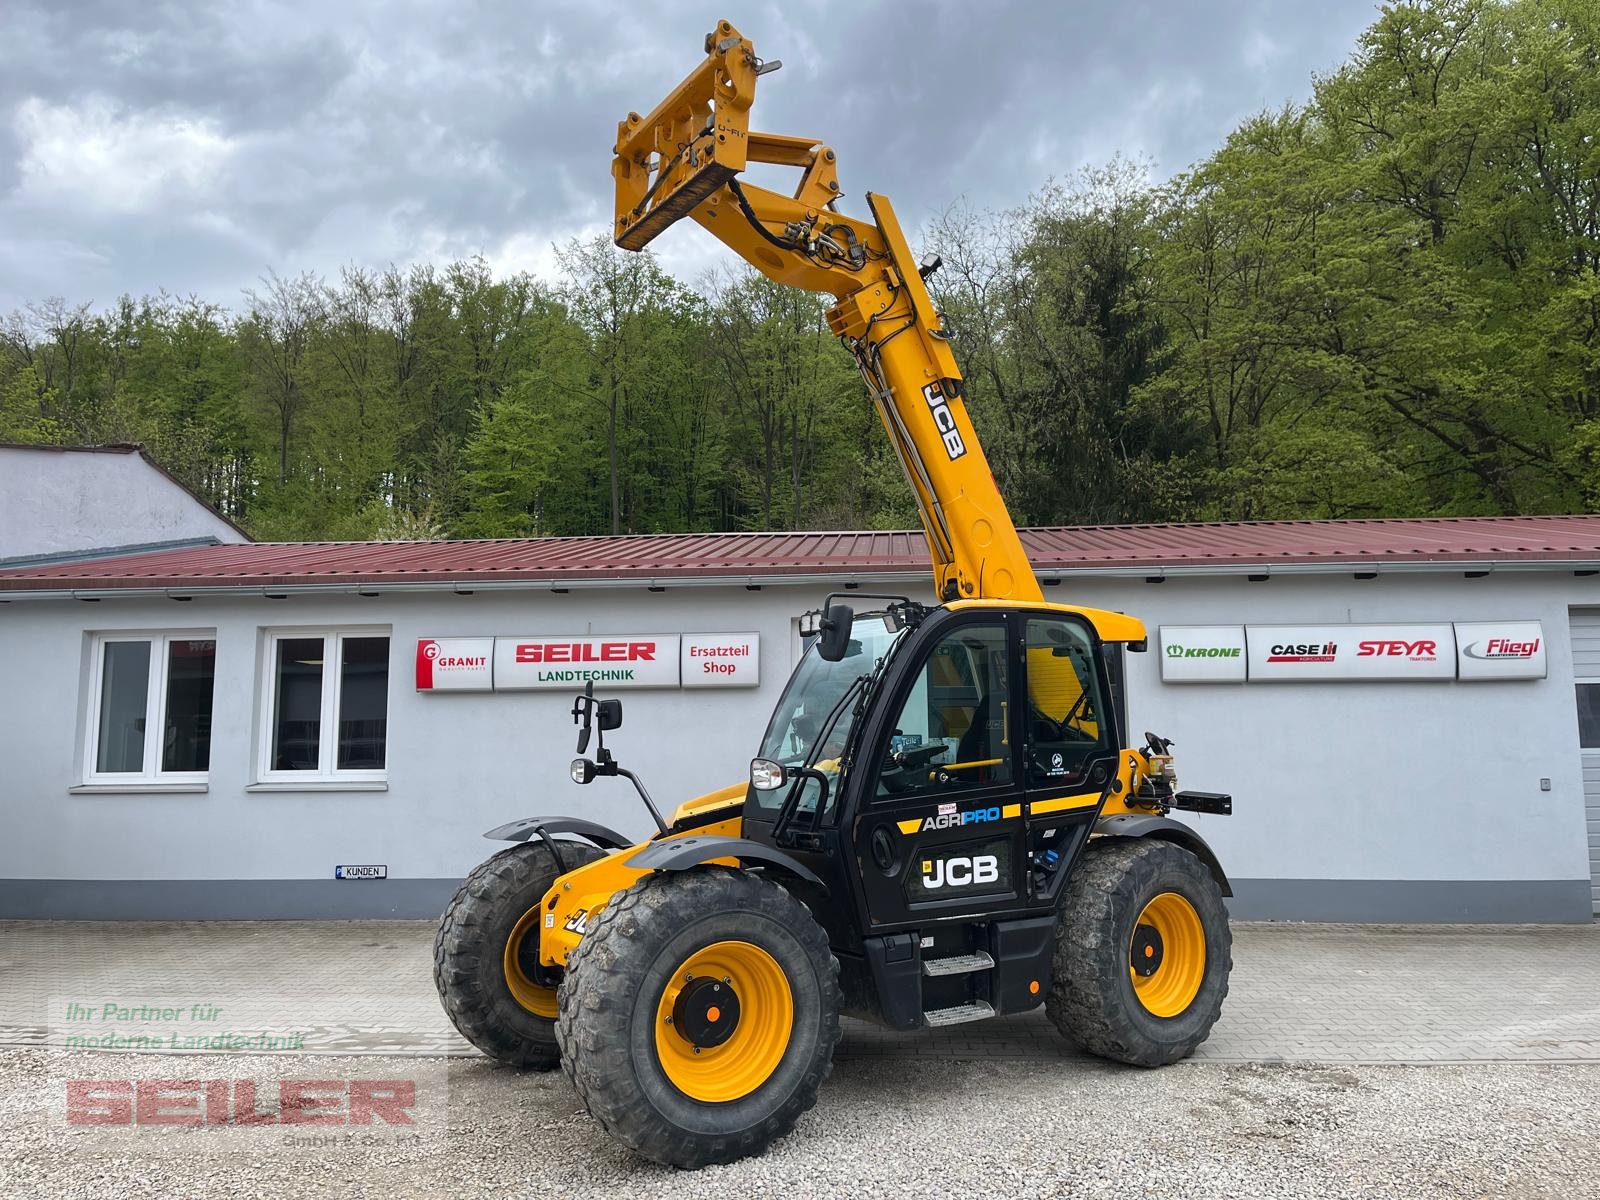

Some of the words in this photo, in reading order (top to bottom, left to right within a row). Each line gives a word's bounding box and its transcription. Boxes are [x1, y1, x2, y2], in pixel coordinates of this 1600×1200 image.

[924, 385, 964, 459] JCB
[516, 642, 656, 662] SEILER
[690, 645, 749, 656] Ersatzteil
[1184, 647, 1241, 658] KRONE
[1270, 645, 1320, 656] CASE
[1356, 640, 1437, 656] STEYR
[1487, 638, 1540, 656] Fliegl
[438, 657, 487, 667] GRANIT
[703, 661, 736, 675] Shop
[538, 669, 634, 681] LANDTECHNIK
[922, 807, 1000, 831] AGRIPRO
[346, 867, 380, 876] KUNDEN
[922, 855, 999, 889] JCB
